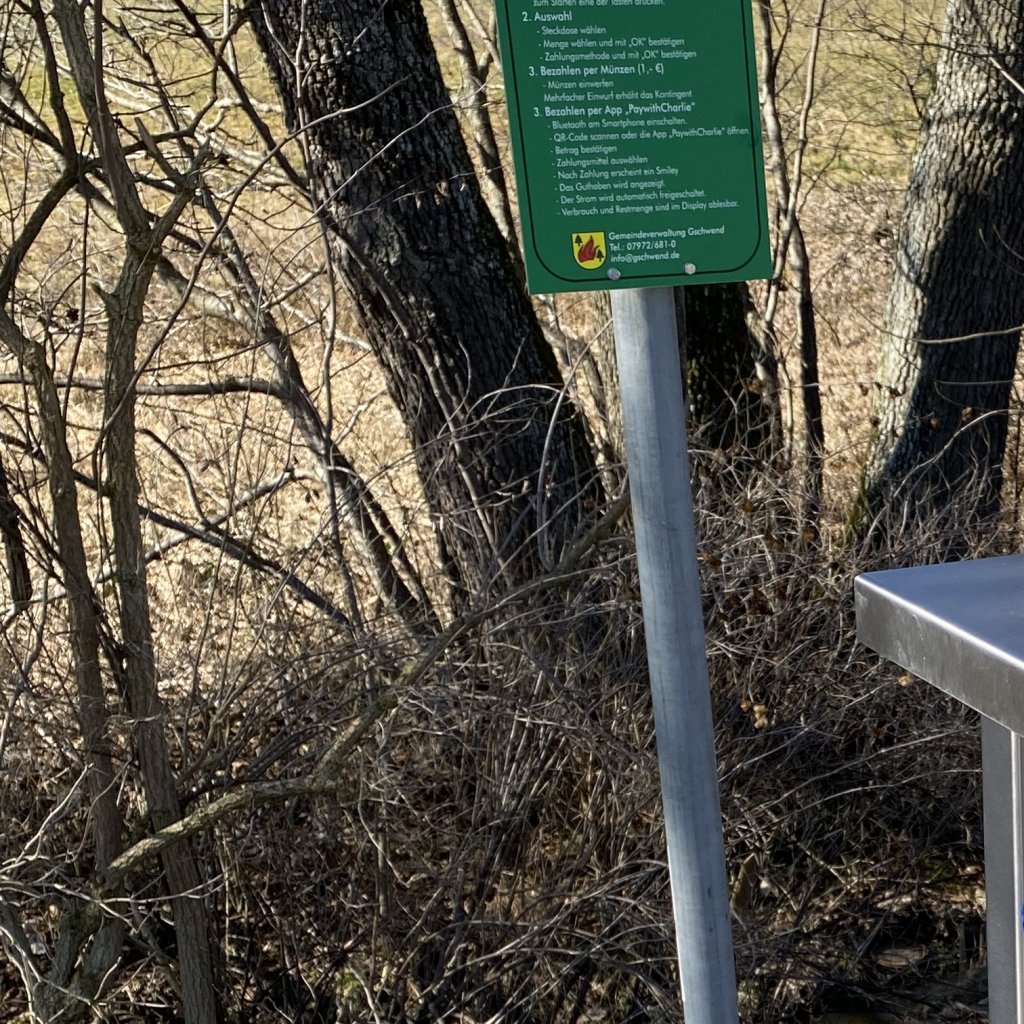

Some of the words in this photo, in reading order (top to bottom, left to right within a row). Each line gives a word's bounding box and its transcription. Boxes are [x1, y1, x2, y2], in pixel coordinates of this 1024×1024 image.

[522, 12, 532, 22] 2.
[534, 10, 572, 21] Auswahl
[542, 26, 578, 34] Steckdose
[580, 25, 606, 34] wählen
[543, 40, 568, 50] Menge
[571, 38, 596, 47] wählen
[599, 38, 613, 46] und
[615, 38, 626, 46] mit
[648, 37, 684, 48] bestätigen
[545, 52, 610, 62] Zahlungsmethode
[612, 50, 626, 59] und
[628, 50, 639, 59] mit
[661, 50, 697, 60] bestätigen
[529, 66, 538, 76] 3.
[540, 66, 580, 76] Bezahlen
[583, 66, 598, 77] per
[600, 65, 635, 74] Münzen
[548, 80, 577, 89] Münzen
[579, 79, 614, 88] einwerfen
[544, 92, 585, 102] Mehrfacher
[587, 91, 614, 101] Einwurf
[616, 91, 638, 100] erhöht
[640, 91, 653, 99] das
[655, 90, 692, 100] Kontingent
[533, 107, 542, 117] 3.
[544, 106, 585, 116] Bezahlen
[588, 107, 602, 117] per
[604, 105, 622, 116] App
[552, 120, 586, 129] Bluetooth
[602, 118, 644, 128] Smartphone
[554, 133, 588, 142] QR-Code
[652, 131, 666, 139] App
[727, 126, 748, 135] öffnen
[555, 146, 579, 156] Betrag
[581, 145, 617, 154] bestätigen
[556, 156, 608, 168] Zahlungsmittel
[611, 155, 648, 165] auswählen
[557, 171, 577, 179] Nach
[579, 169, 609, 179] Zahlung
[611, 168, 642, 177] erscheint
[656, 166, 679, 176] Smiley
[559, 183, 574, 192] Das
[576, 182, 611, 191] Guthaben
[576, 195, 597, 203] Strom
[599, 194, 614, 202] wird
[616, 191, 658, 201] automatisch
[562, 206, 598, 216] Verbrauch
[600, 206, 614, 214] und
[616, 204, 653, 214] Restmenge
[655, 202, 669, 211] sind
[682, 201, 707, 210] Display
[608, 229, 686, 240] Gemeindeverwaltung
[688, 225, 725, 235] Gschwend
[627, 240, 676, 251] 07972/681-0
[611, 251, 680, 263] info@gschwend.de
